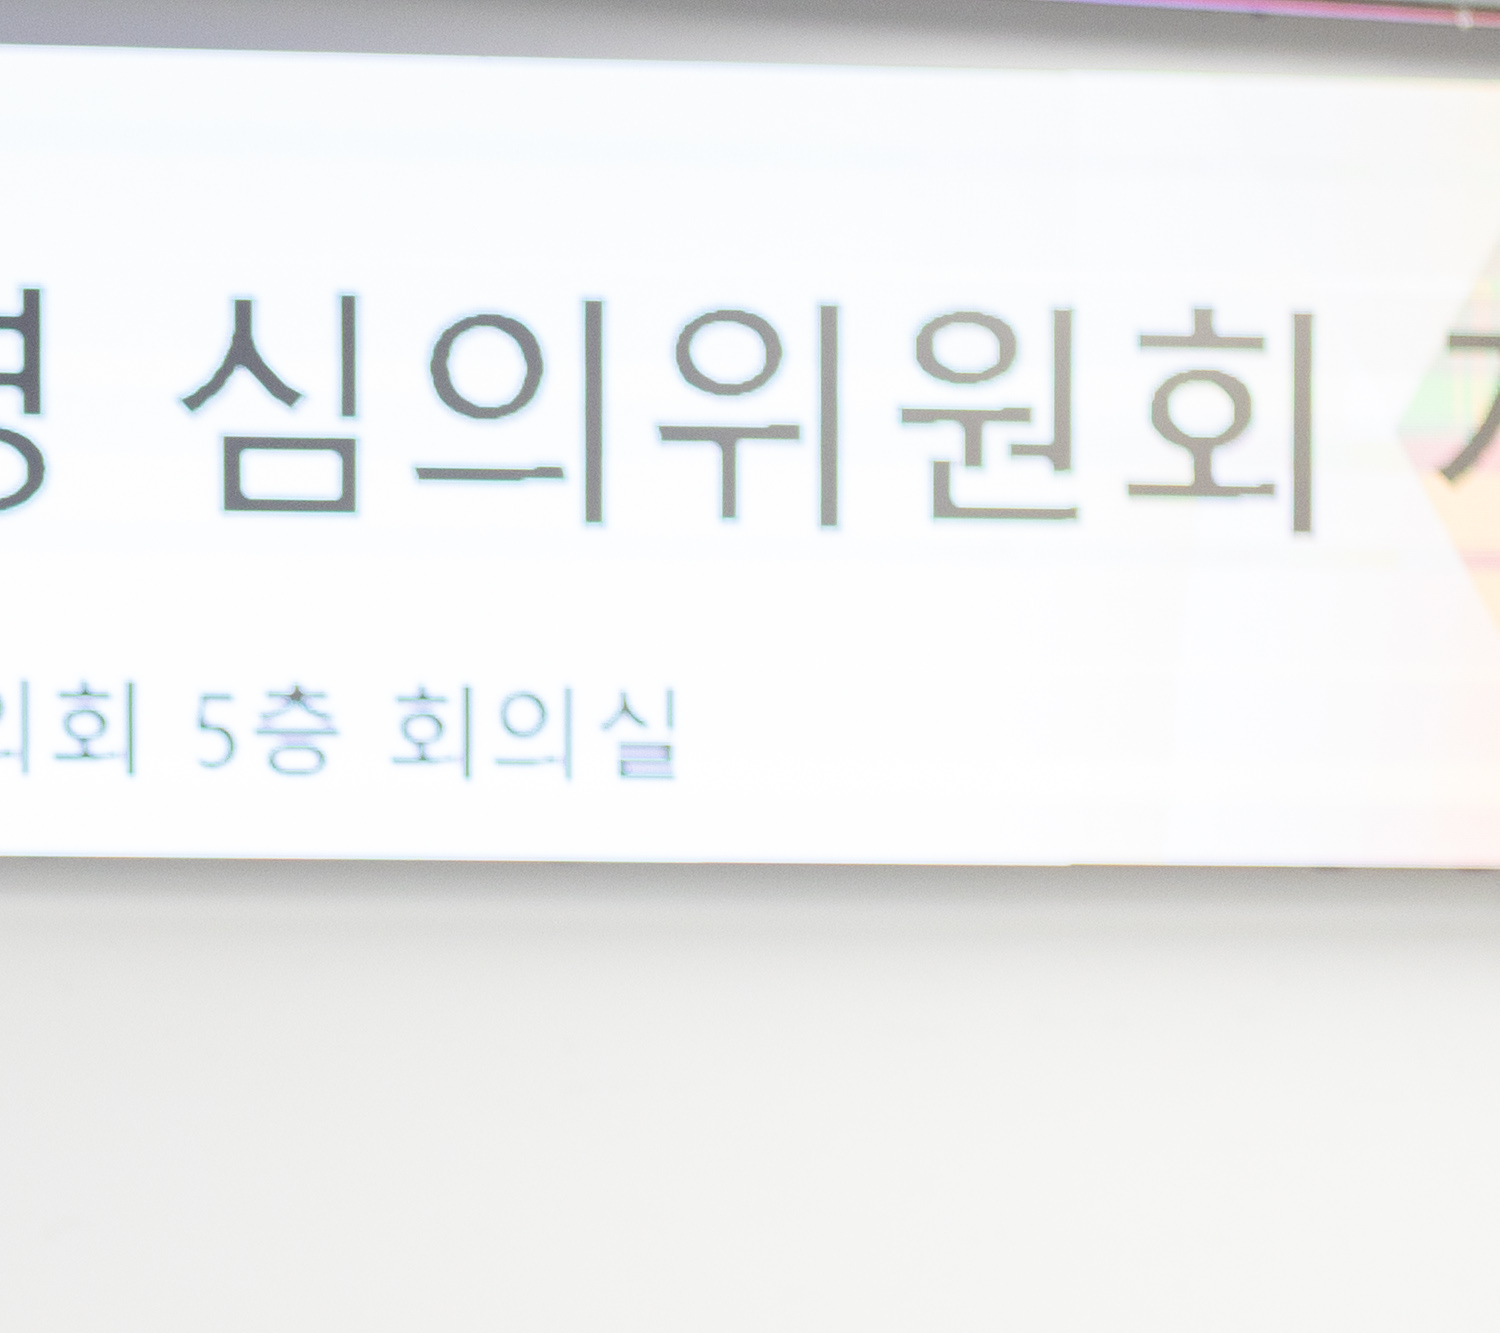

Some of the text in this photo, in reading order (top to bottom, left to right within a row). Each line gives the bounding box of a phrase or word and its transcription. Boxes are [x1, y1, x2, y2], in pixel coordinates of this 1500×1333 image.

[177, 291, 1314, 535] 심의위원회
[195, 681, 341, 778] 5층
[390, 683, 676, 782] 회의실
